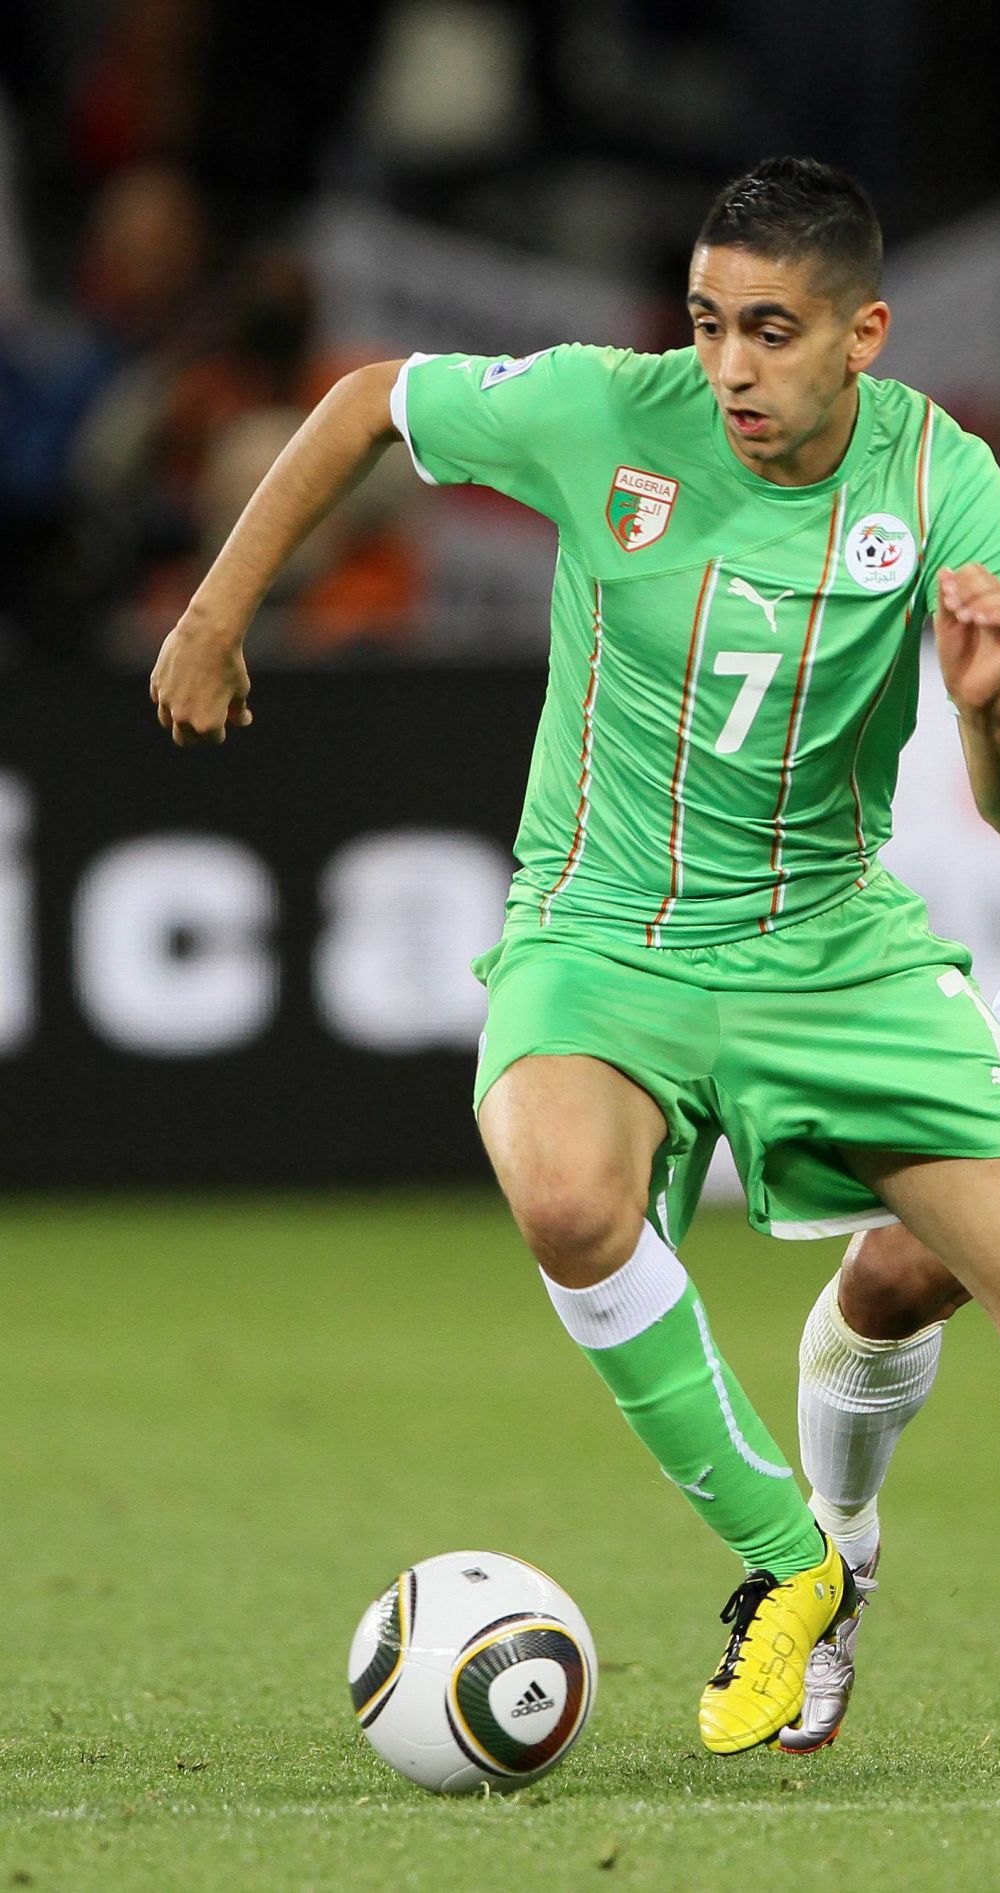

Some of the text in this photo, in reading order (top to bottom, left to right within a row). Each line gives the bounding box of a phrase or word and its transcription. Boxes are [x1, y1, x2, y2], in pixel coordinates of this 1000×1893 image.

[619, 474, 671, 497] ALGERIA
[713, 651, 784, 753] 7
[752, 1631, 796, 1697] F50
[511, 1699, 555, 1718] adidas
